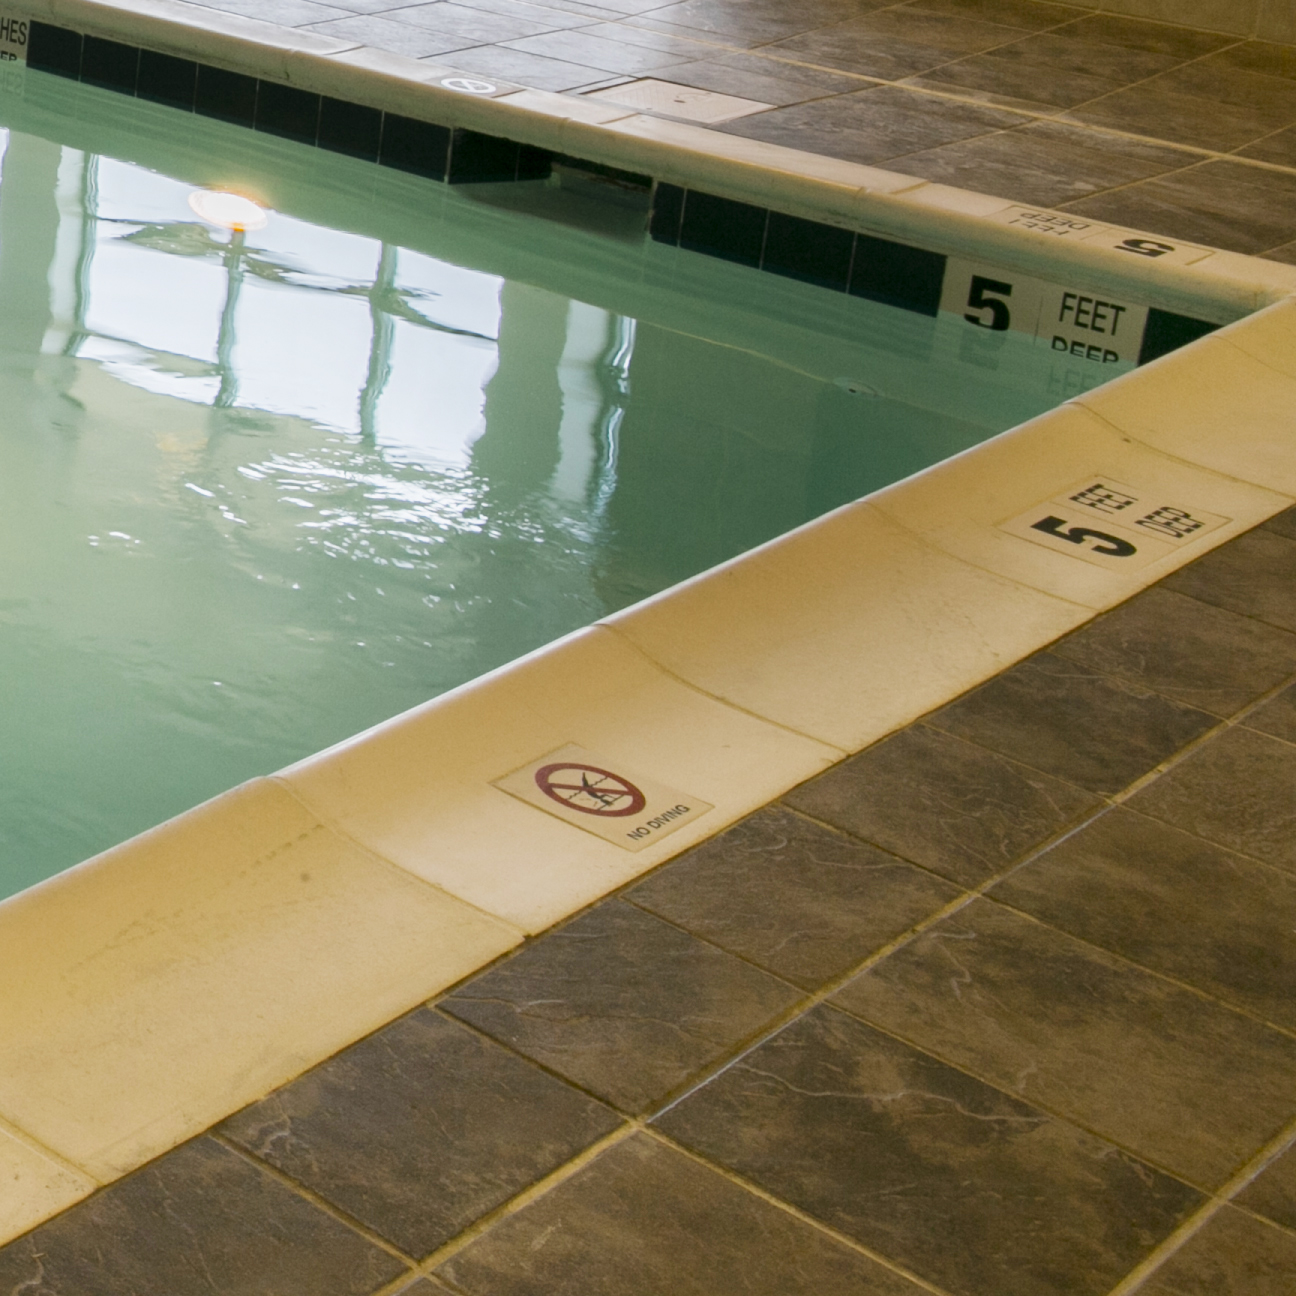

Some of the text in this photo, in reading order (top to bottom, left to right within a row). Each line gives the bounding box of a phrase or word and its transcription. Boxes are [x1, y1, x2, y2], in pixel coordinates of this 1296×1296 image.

[1019, 212, 1091, 230] DEEP
[1114, 238, 1175, 258] 5
[964, 275, 1126, 336] 5 FEET
[1068, 483, 1138, 515] FEET
[1030, 516, 1137, 557] 5
[1134, 506, 1206, 538] DEEP
[626, 804, 690, 841] NO DIVING
